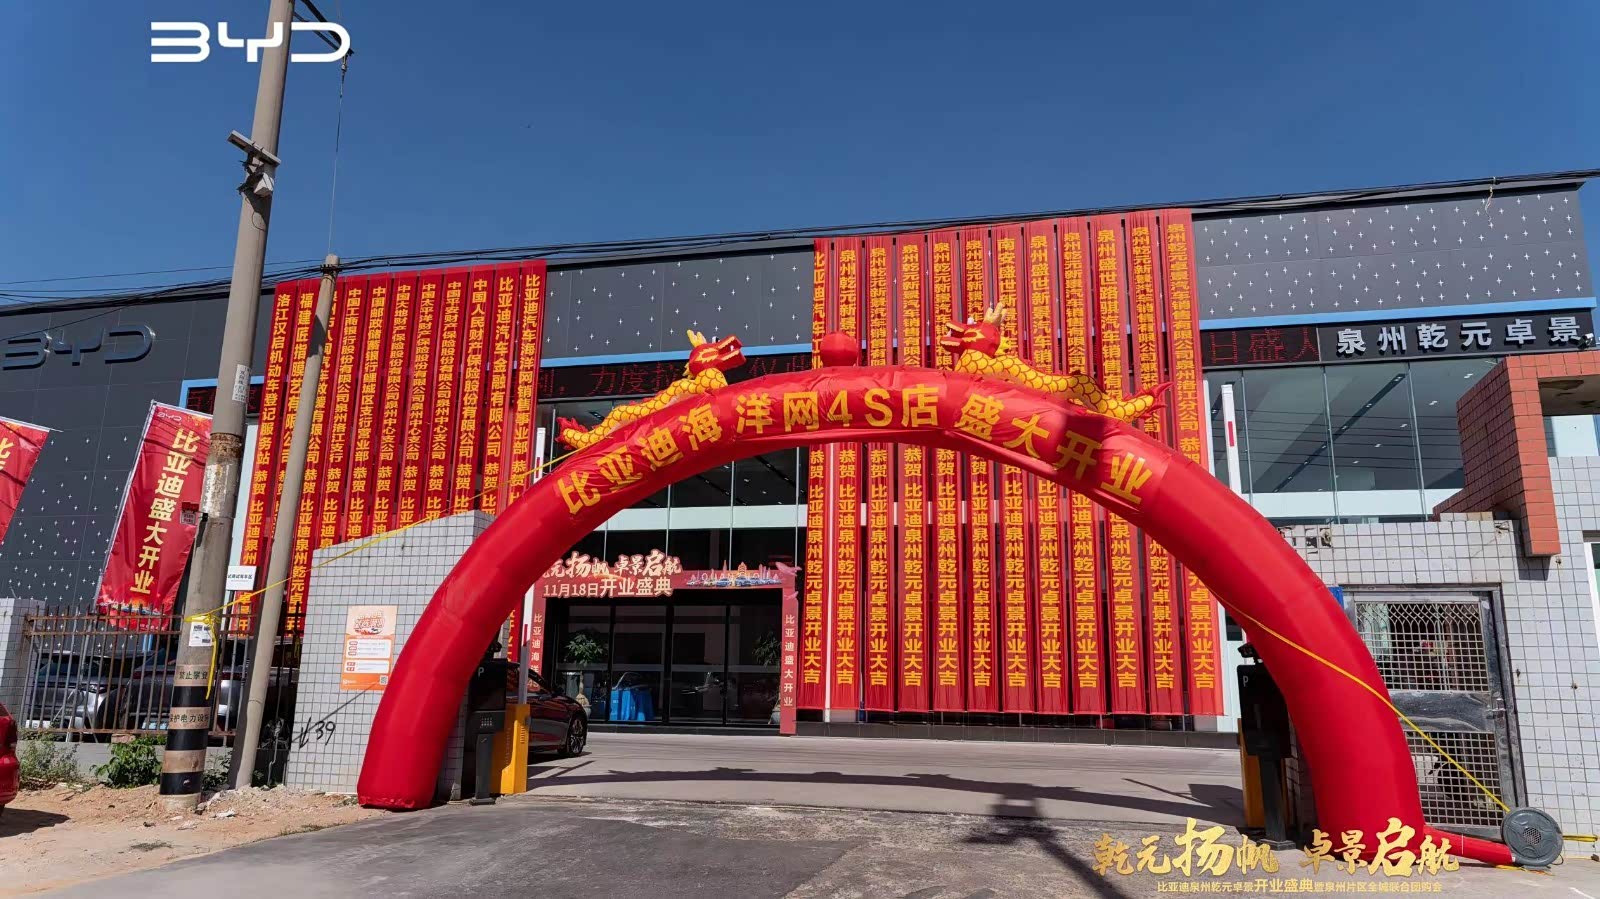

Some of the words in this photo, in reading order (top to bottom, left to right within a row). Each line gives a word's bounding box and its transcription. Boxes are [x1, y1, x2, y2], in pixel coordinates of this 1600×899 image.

[3, 325, 156, 370] BYD
[1337, 317, 1581, 355] 泉州乾元卓景
[487, 277, 514, 457] 比亚迪汽车金融有限公司
[558, 384, 1153, 515] 比亚迪海洋网4S店盛大开业
[809, 450, 824, 478] 恭贺
[839, 450, 856, 478] 恭贺
[871, 450, 887, 478] 恭贺
[904, 448, 922, 477] 恭贺
[252, 470, 268, 495] 恭贺
[303, 469, 317, 494] 恭贺
[326, 468, 341, 492] 恭贺
[352, 467, 367, 492] 恭贺
[376, 466, 392, 492] 恭贺
[403, 465, 418, 491] 恭贺
[428, 465, 444, 490] 恭贺
[455, 464, 472, 490] 恭贺
[483, 463, 499, 489] 恭贺
[130, 428, 201, 595] 比亚迪盛大开业
[542, 551, 609, 578] 元扬帆
[543, 577, 673, 597] 11月18日开业盛典
[804, 485, 824, 684] 比亚迪泉州乾元卓景开业大吉
[837, 484, 856, 684] 比亚迪泉州乾元卓景开业大吉
[869, 484, 888, 686] 比亚迪泉州乾元卓景开业大吉
[904, 482, 923, 686] 比亚迪泉州乾元卓景开业大吉
[937, 482, 957, 687] 比亚迪泉州乾元卓景开业大吉
[972, 481, 991, 687] 比亚迪泉州乾元卓景开业大吉
[1004, 480, 1026, 687] 比亚迪泉州乾元卓景开业大吉
[1038, 480, 1062, 688] 比亚迪泉州乾元卓景开业大吉
[783, 615, 795, 706] 比亚迪盛大开业
